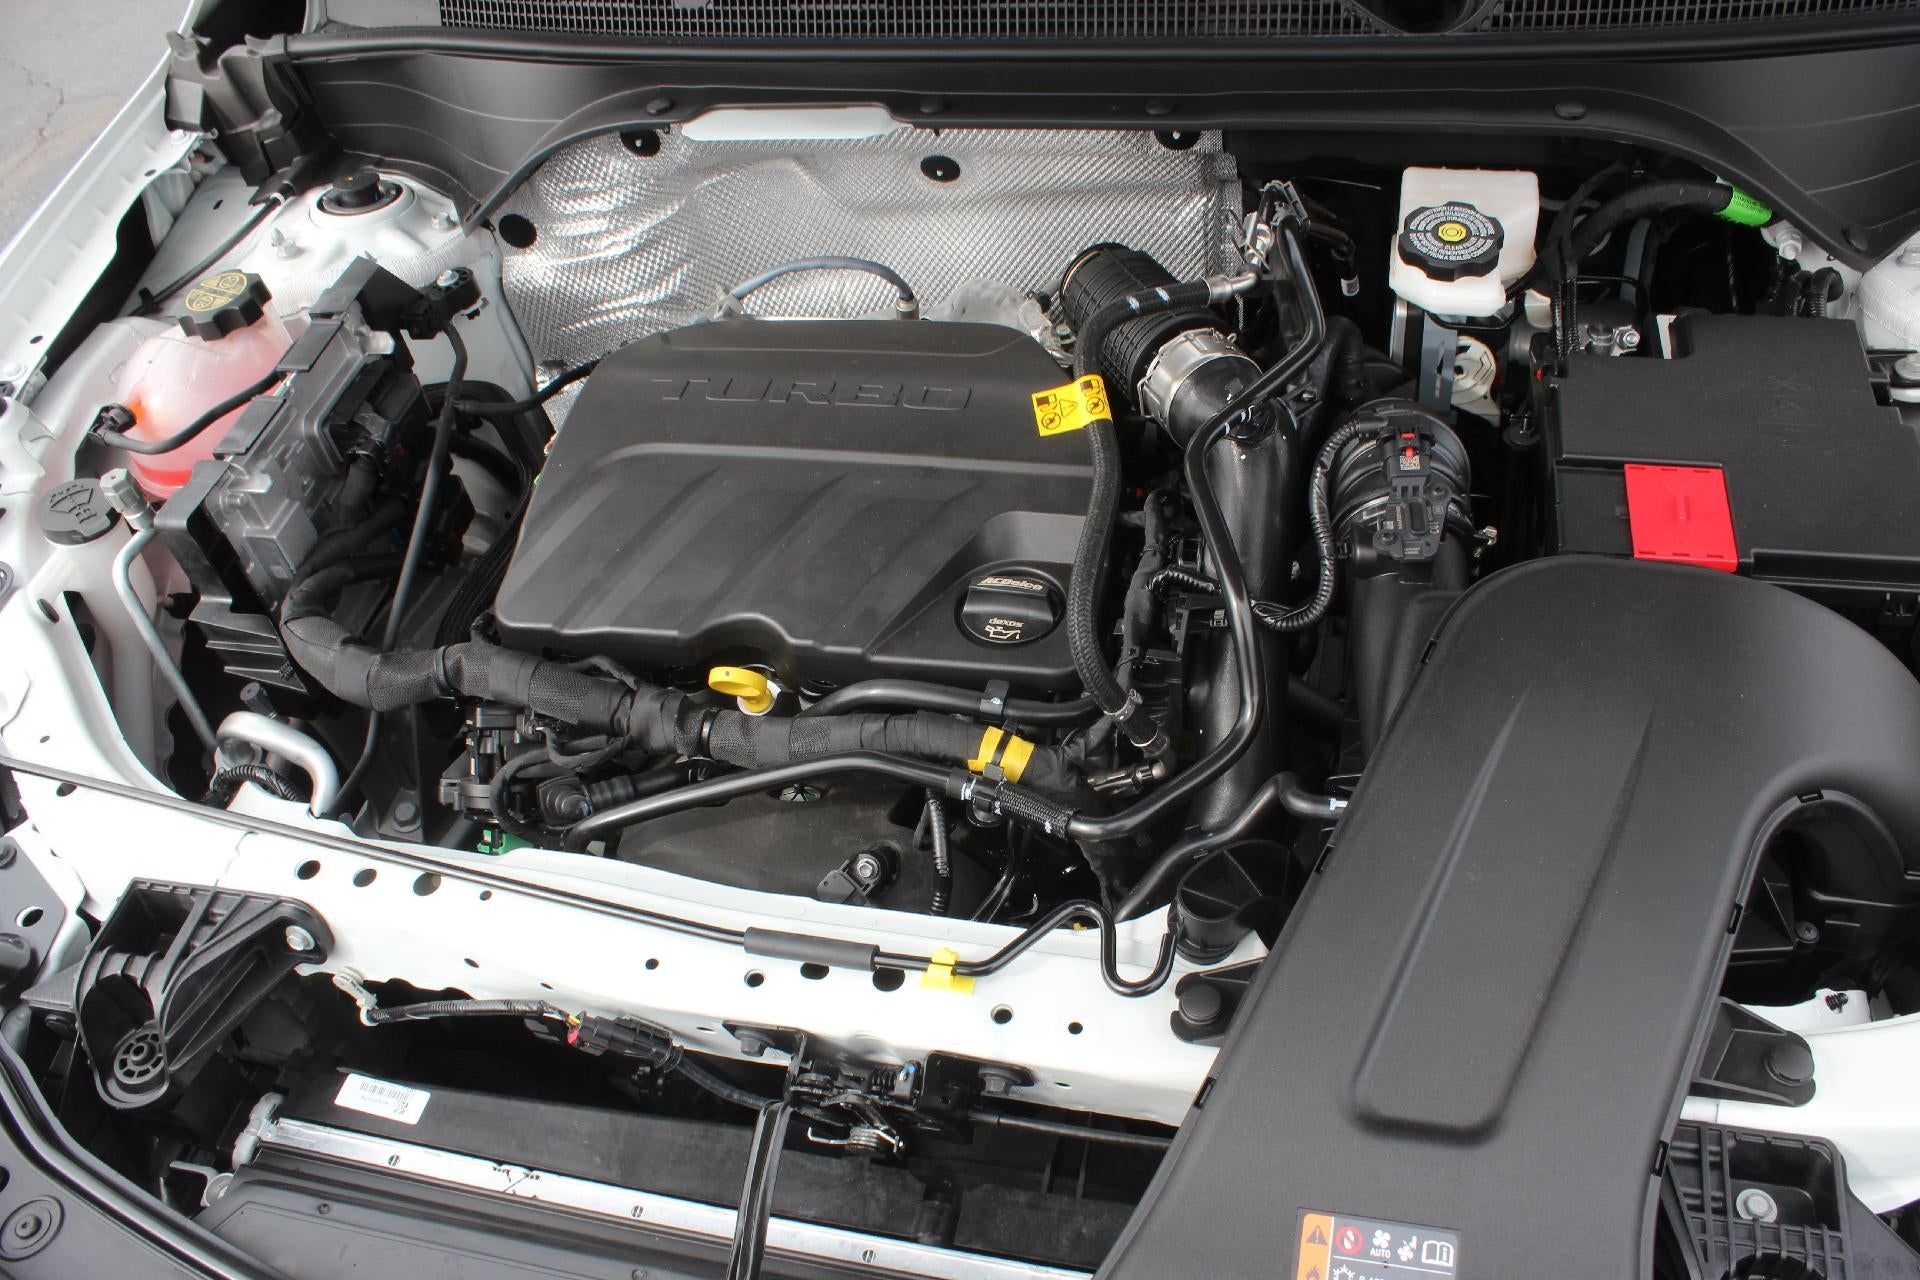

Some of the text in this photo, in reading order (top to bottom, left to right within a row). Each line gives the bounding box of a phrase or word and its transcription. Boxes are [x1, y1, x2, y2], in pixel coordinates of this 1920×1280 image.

[652, 376, 973, 411] TURBO
[978, 577, 1043, 591] ACDelco
[989, 617, 1025, 628] dexos
[1370, 1247, 1391, 1258] AUTO
